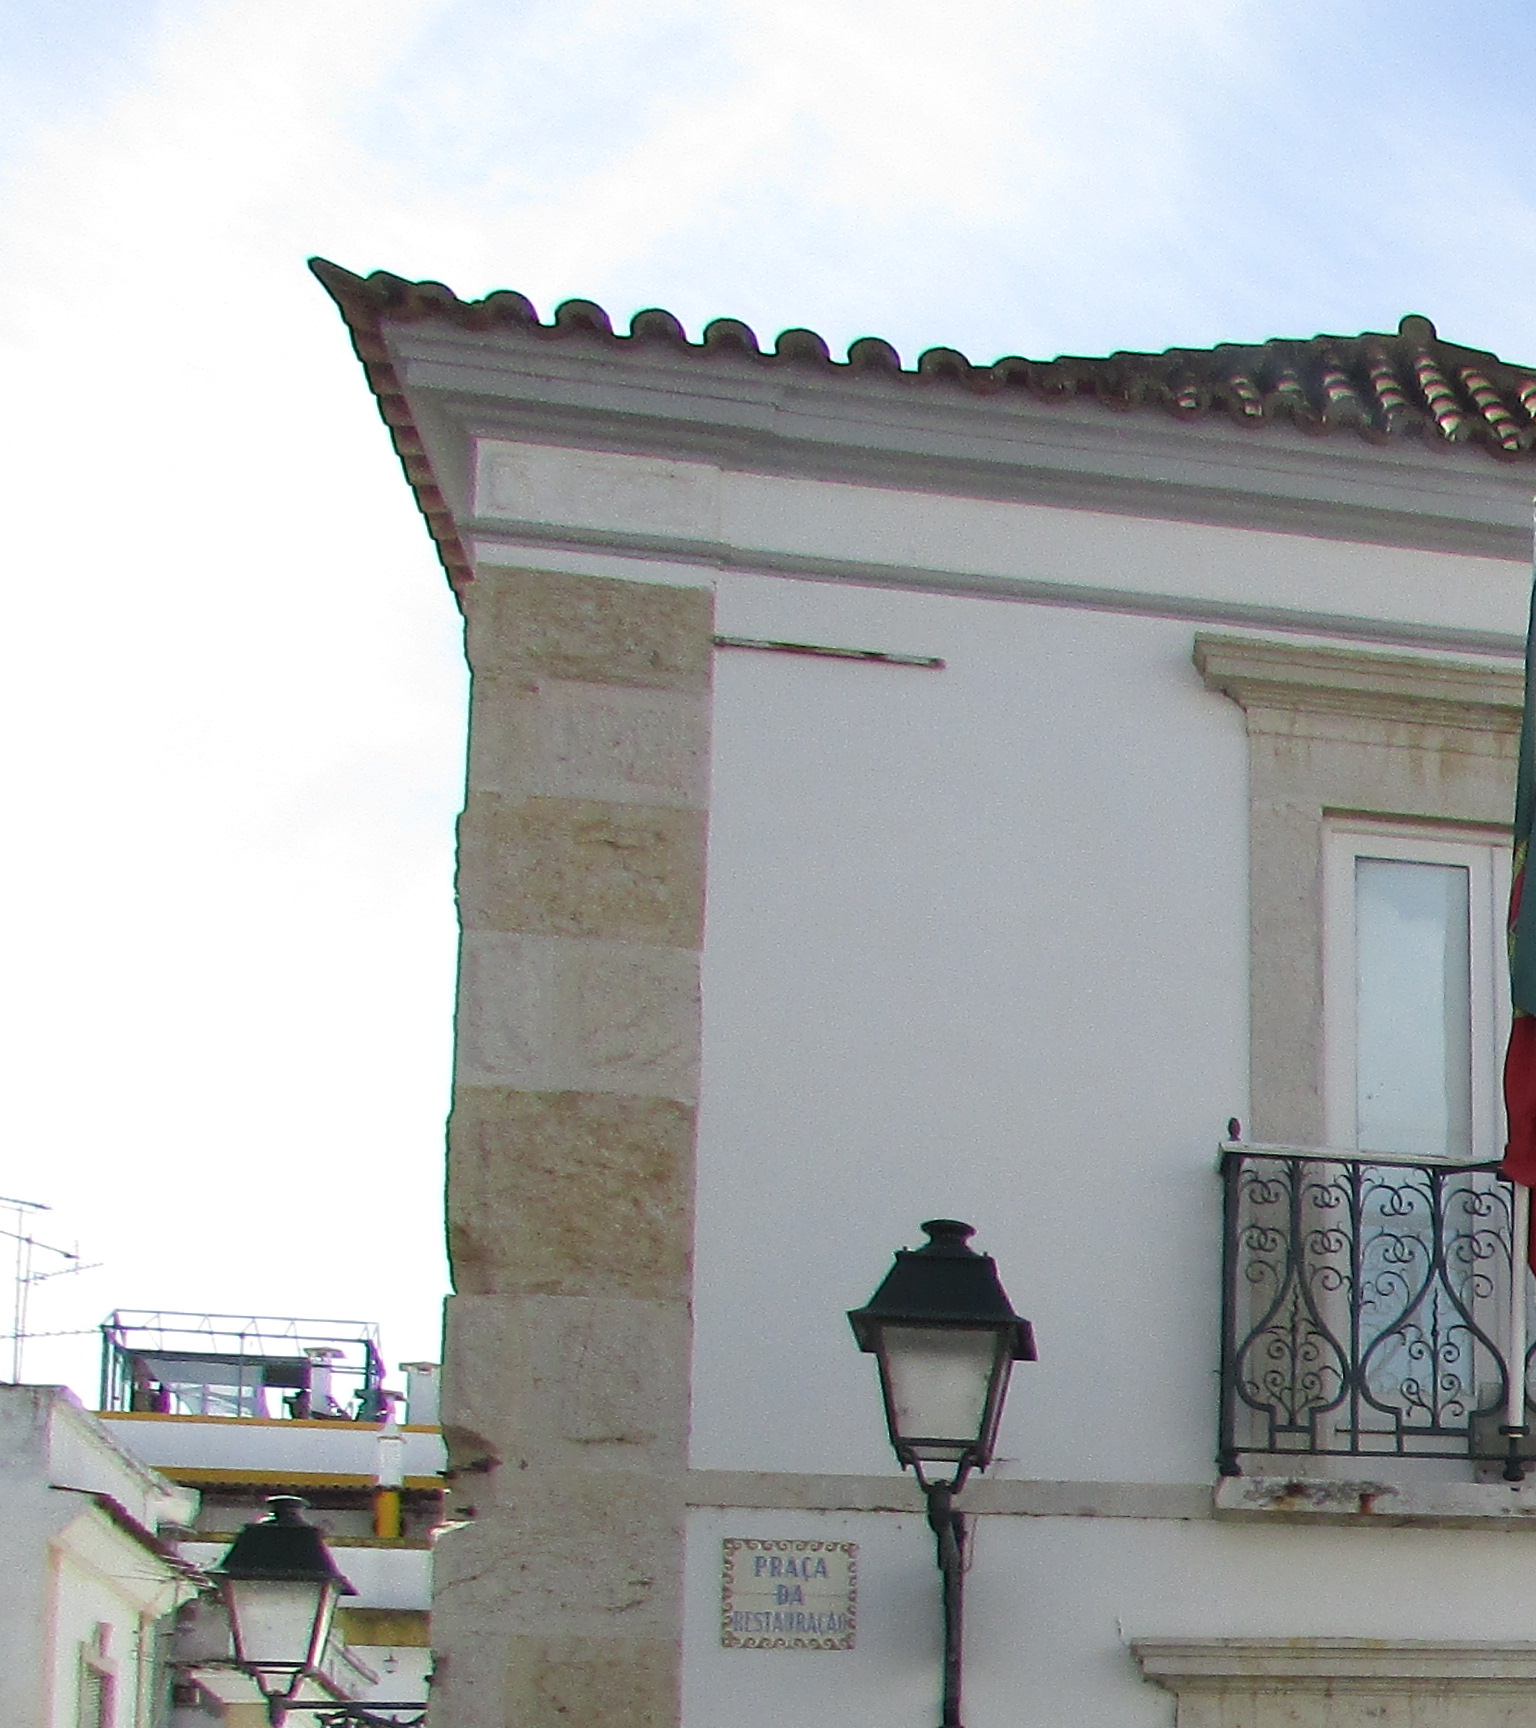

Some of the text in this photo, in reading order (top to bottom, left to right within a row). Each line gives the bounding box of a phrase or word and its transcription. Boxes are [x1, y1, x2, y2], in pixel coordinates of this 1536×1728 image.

[754, 1555, 828, 1581] PRAÇA
[777, 1584, 804, 1606] DA
[733, 1609, 848, 1634] RESTAURAÇÃO
